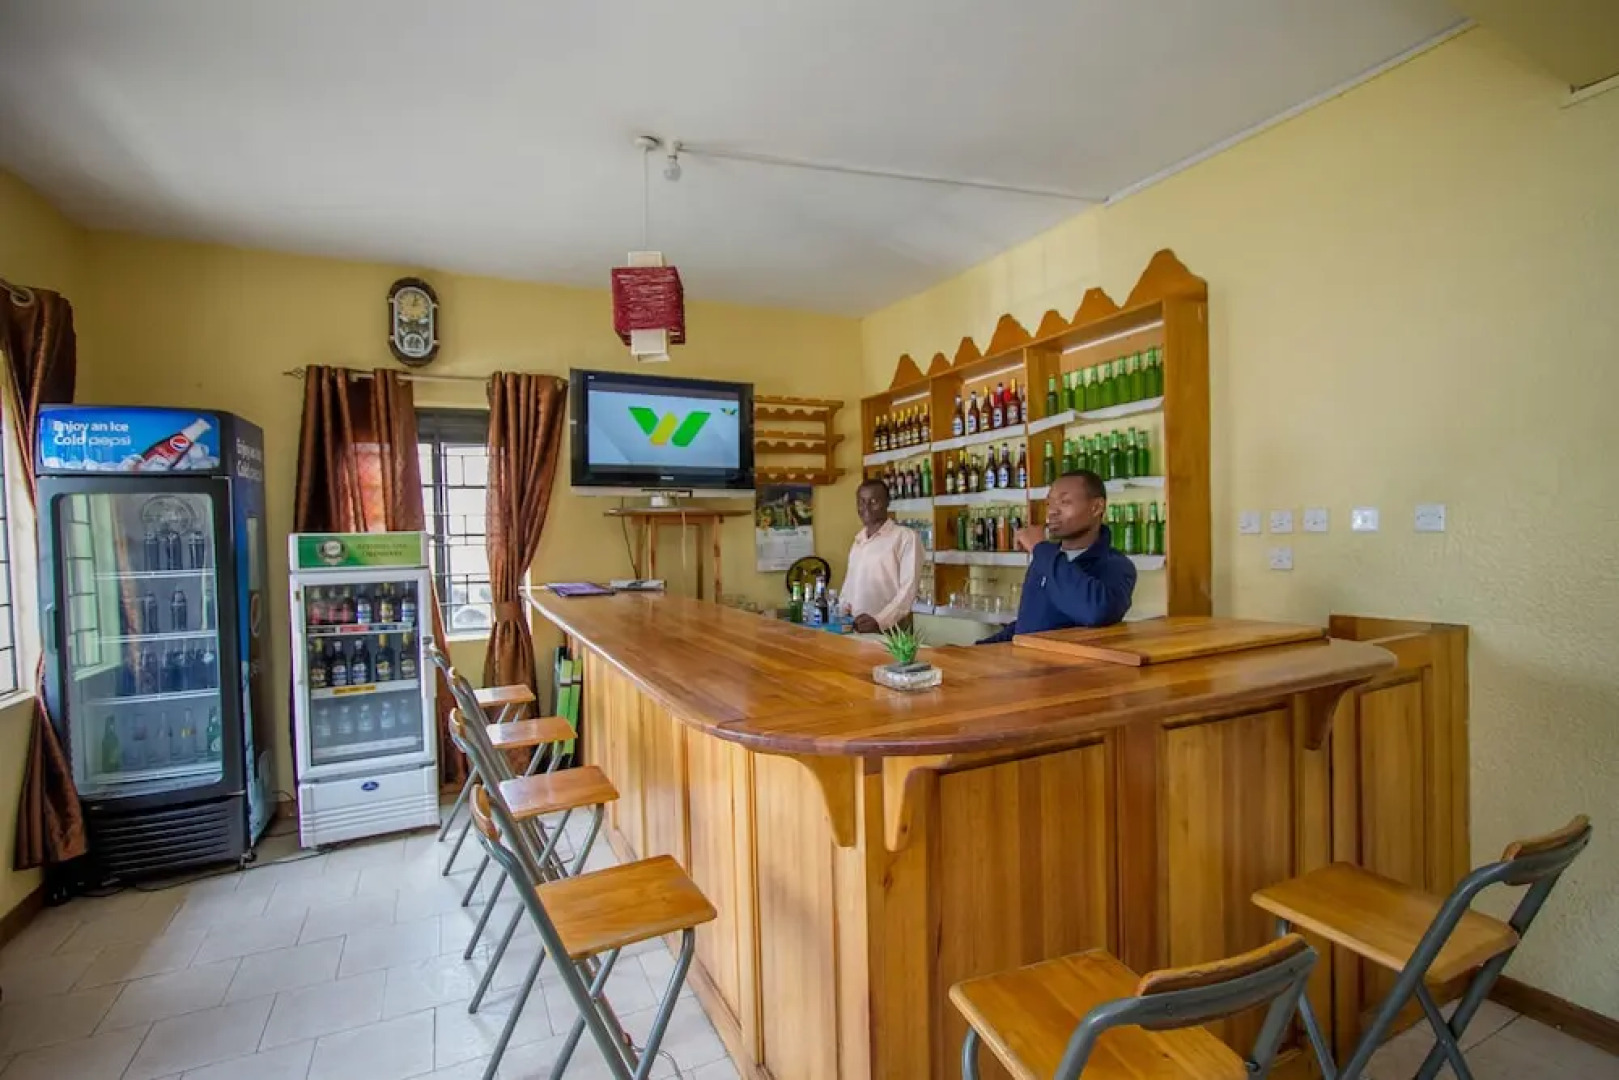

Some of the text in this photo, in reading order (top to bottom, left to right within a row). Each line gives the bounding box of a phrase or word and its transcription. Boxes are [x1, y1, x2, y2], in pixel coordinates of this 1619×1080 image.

[54, 421, 89, 434] Enjoy
[91, 423, 107, 432] an
[55, 433, 131, 448] Cold pepsi
